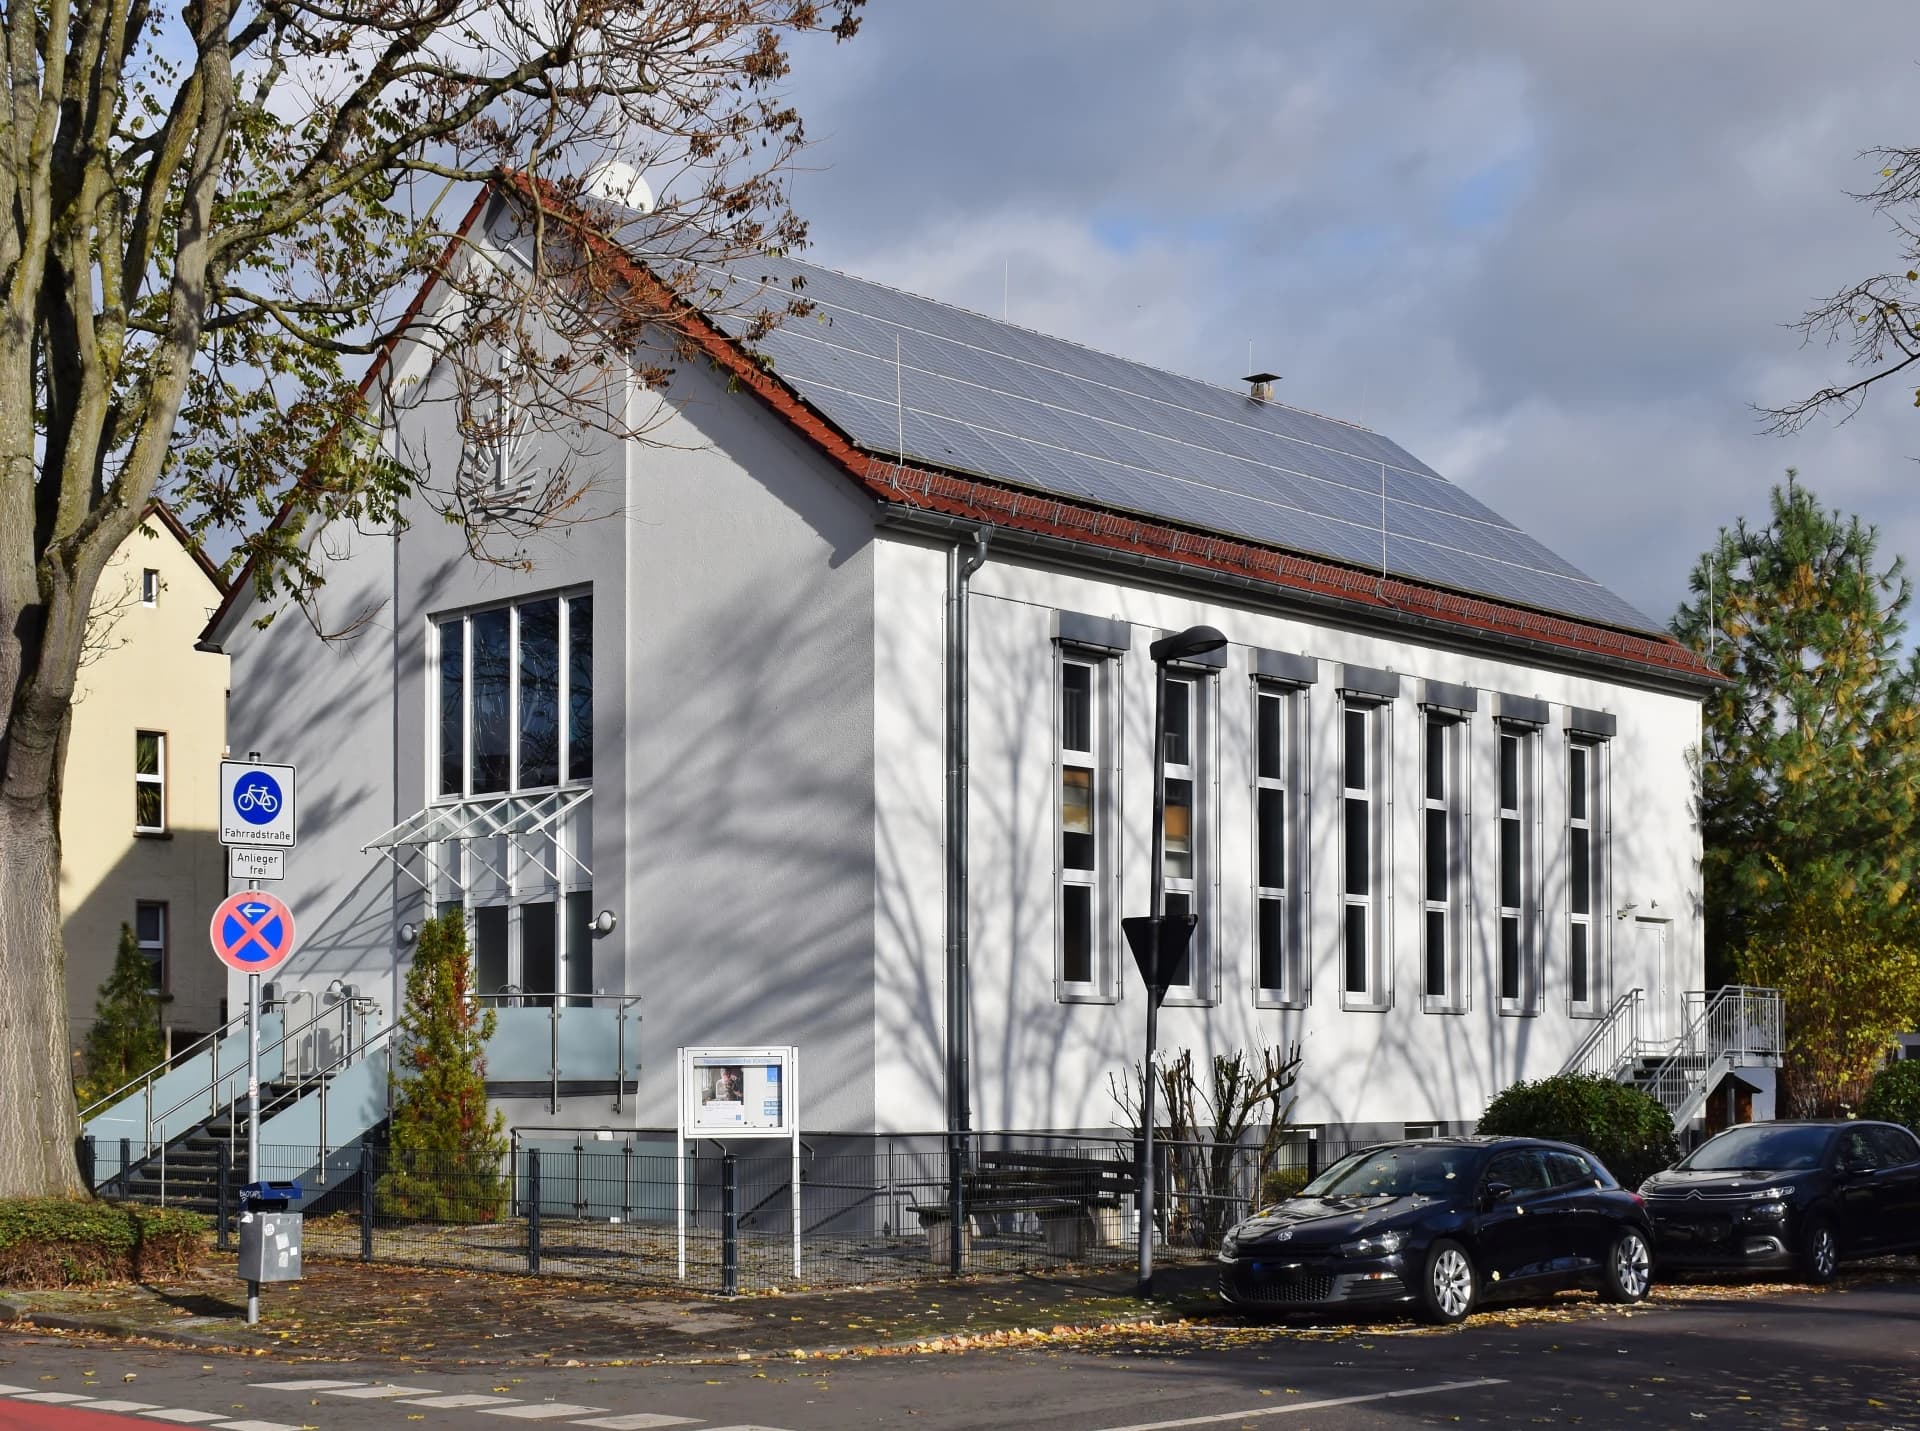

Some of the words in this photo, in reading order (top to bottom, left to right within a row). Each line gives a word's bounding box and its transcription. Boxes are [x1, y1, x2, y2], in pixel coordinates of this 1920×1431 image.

[225, 827, 291, 840] Fahrradstraße
[237, 853, 278, 865] Anlieger
[250, 865, 266, 875] frei
